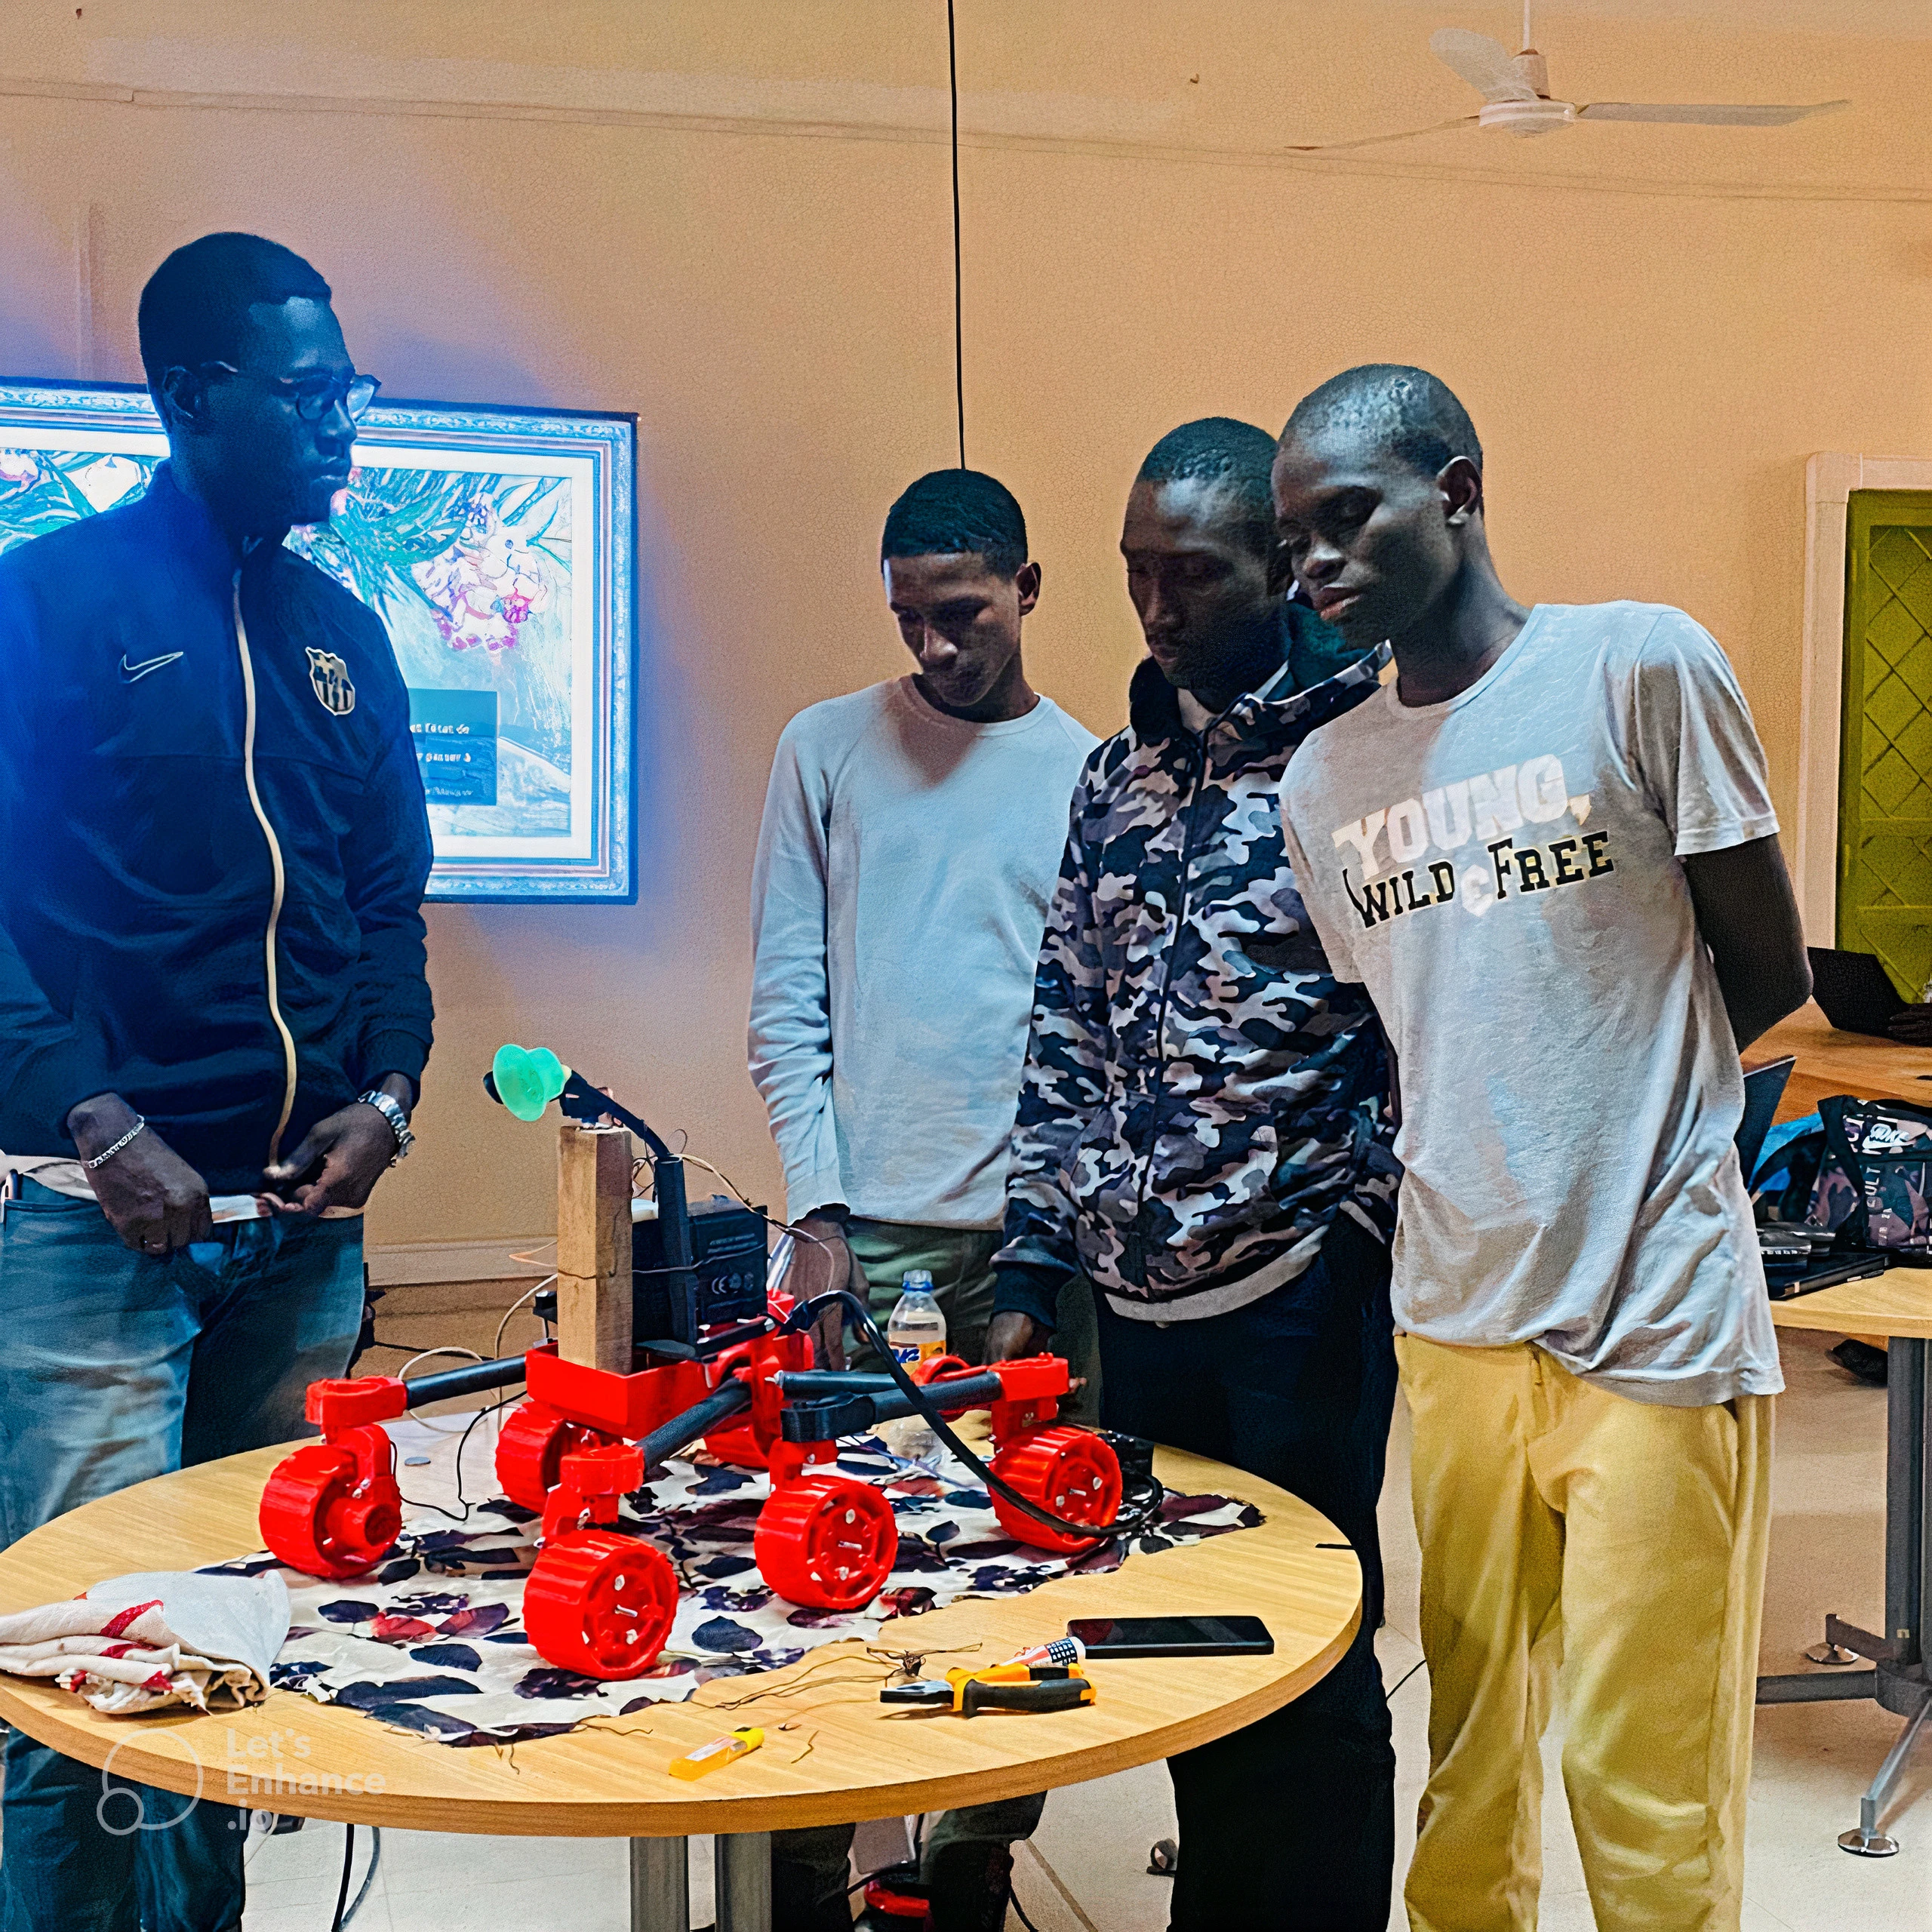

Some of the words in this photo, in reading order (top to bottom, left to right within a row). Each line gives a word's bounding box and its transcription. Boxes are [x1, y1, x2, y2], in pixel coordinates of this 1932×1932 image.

[1331, 754, 1591, 880] YOUNG,
[1343, 860, 1455, 928] WILD
[1487, 830, 1615, 900] FREE
